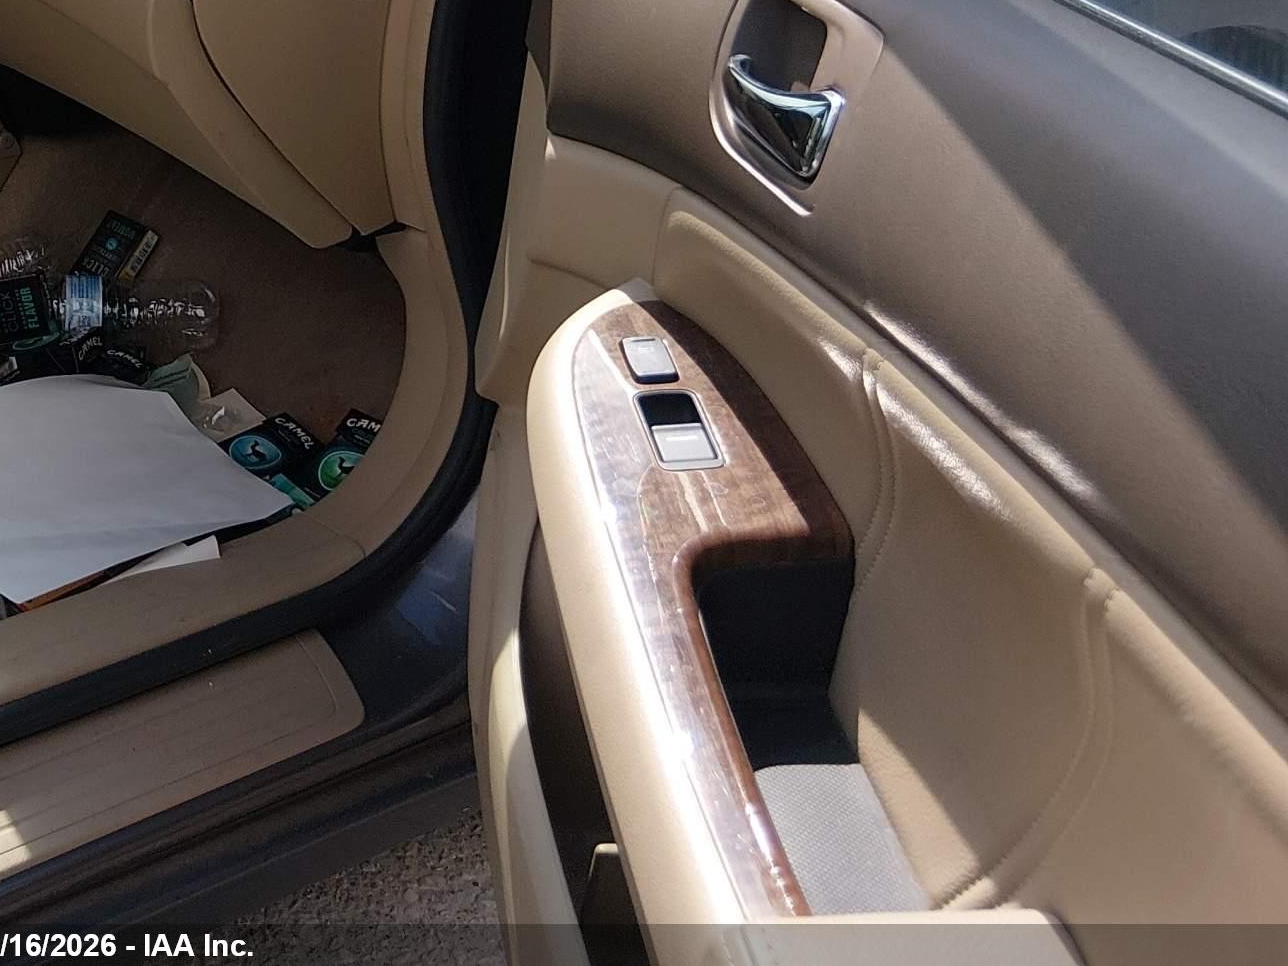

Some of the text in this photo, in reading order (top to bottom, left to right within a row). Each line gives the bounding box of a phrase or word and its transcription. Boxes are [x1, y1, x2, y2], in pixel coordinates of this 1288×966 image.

[20, 287, 40, 329] FLAVOR
[78, 336, 103, 360] CAMEL
[107, 349, 143, 369] CAMEL
[274, 417, 314, 450] CAMEL
